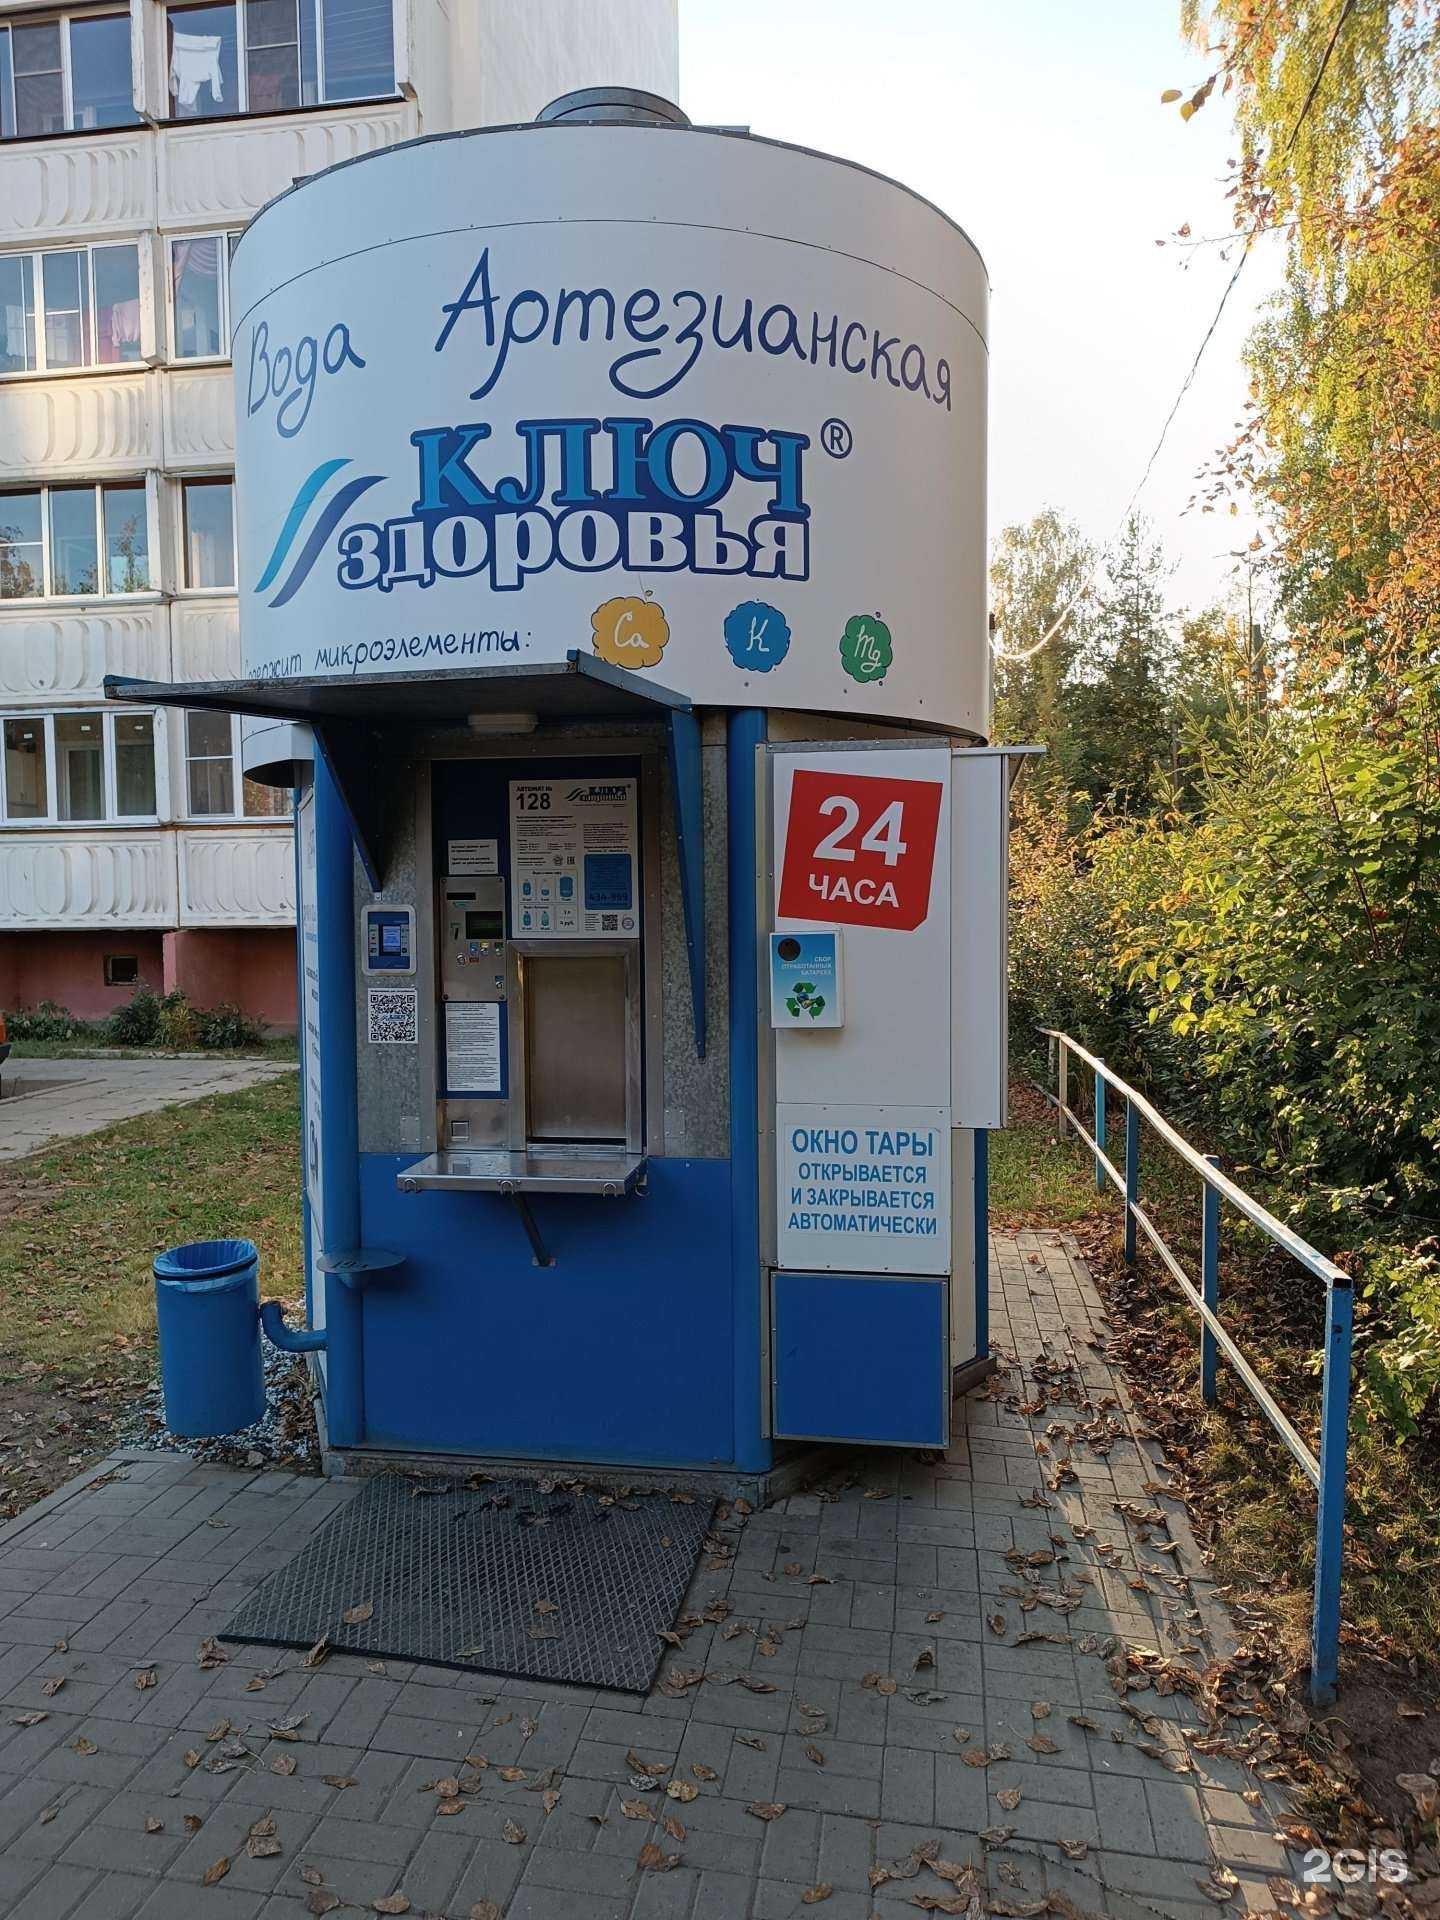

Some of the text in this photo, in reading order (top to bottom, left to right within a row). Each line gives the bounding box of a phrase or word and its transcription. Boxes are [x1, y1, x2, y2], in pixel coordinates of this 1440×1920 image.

[247, 246, 952, 439] Вода Артезианская
[410, 417, 811, 520] КЛЮЧ
[314, 629, 533, 675] микроэлементы:
[516, 793, 552, 811] 128
[811, 794, 907, 868] 24
[808, 873, 900, 909] ЧАСА
[791, 1128, 933, 1158] ОКНО ТАРЫ
[798, 1161, 927, 1185] ОТКРЫВАЕТСЯ
[791, 1187, 935, 1210] И ЗАКРЫВАЕТСЯ
[788, 1211, 938, 1236] АВТОМАТИЧЕСКИ
